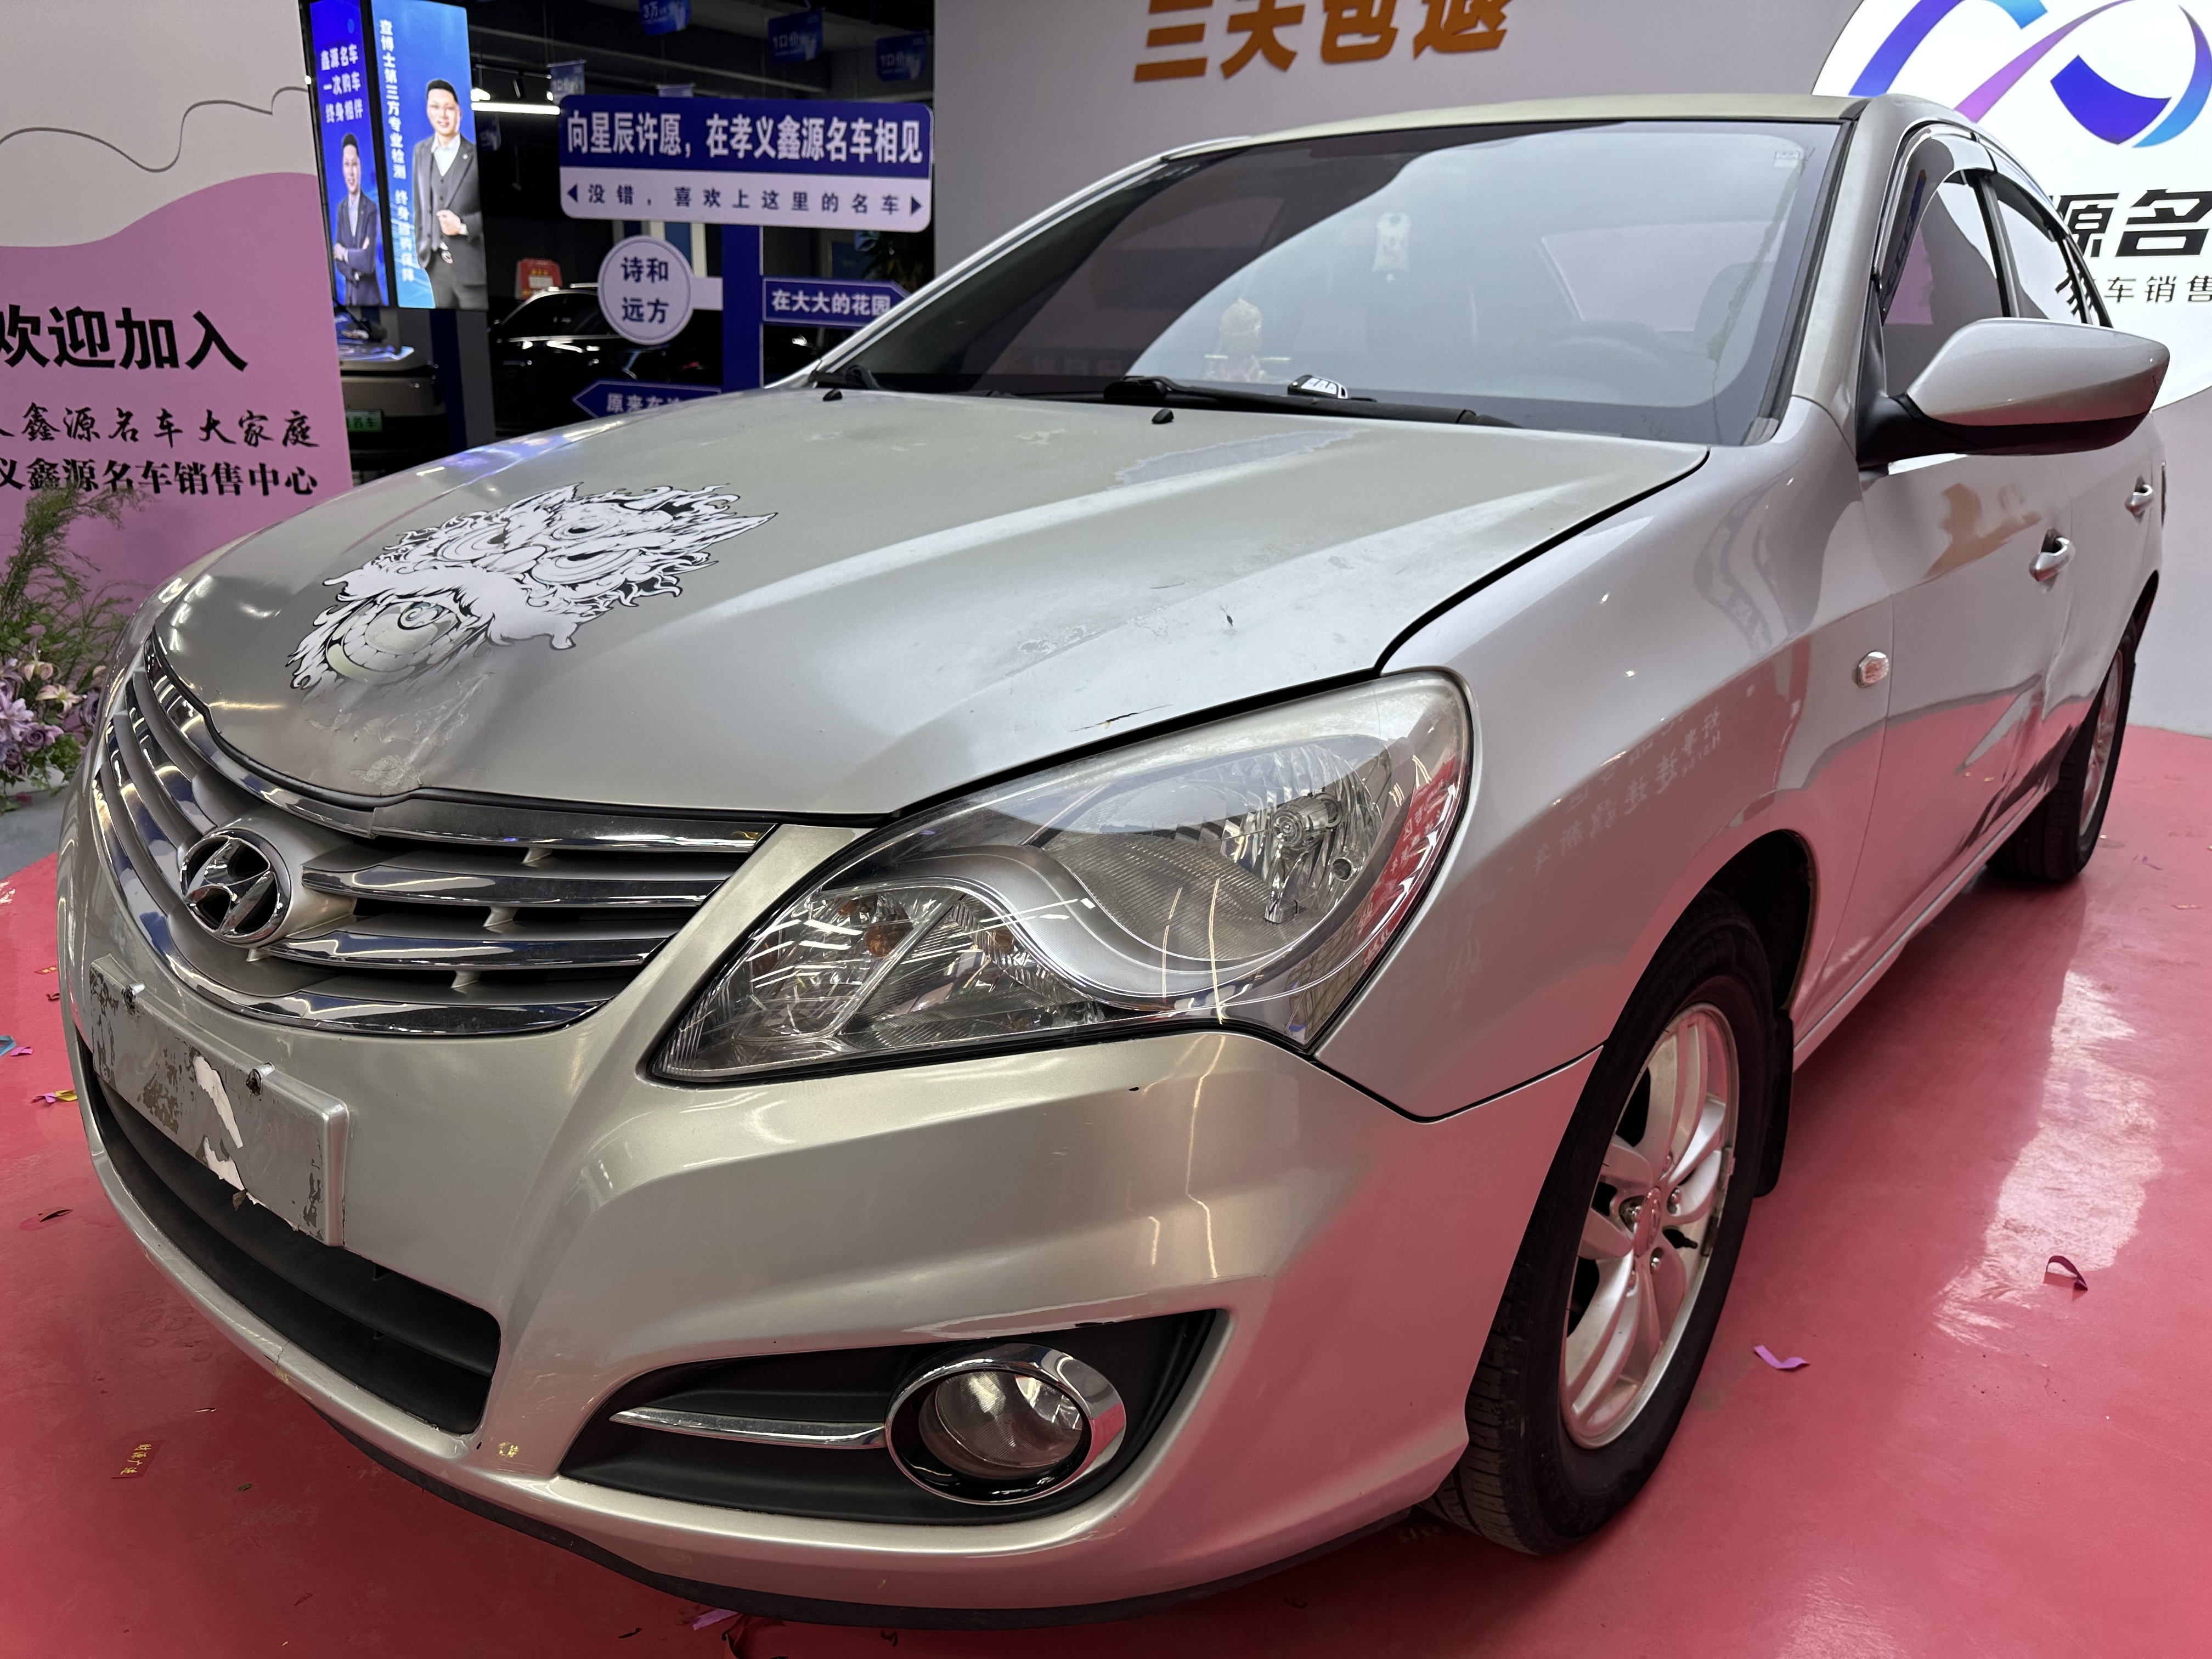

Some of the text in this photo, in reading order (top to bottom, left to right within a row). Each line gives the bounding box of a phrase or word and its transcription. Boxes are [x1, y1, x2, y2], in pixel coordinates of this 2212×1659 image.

[321, 43, 358, 71] 鑫源名车
[323, 71, 361, 95] 一次购车
[325, 98, 363, 123] 终身相伴
[567, 111, 923, 163] 向星辰许愿，在孝义鑫源名车相见
[622, 257, 669, 283] 诗和
[622, 298, 670, 324] 远方
[771, 289, 891, 317] 在大大的花园
[0, 304, 249, 371] 欢迎加入
